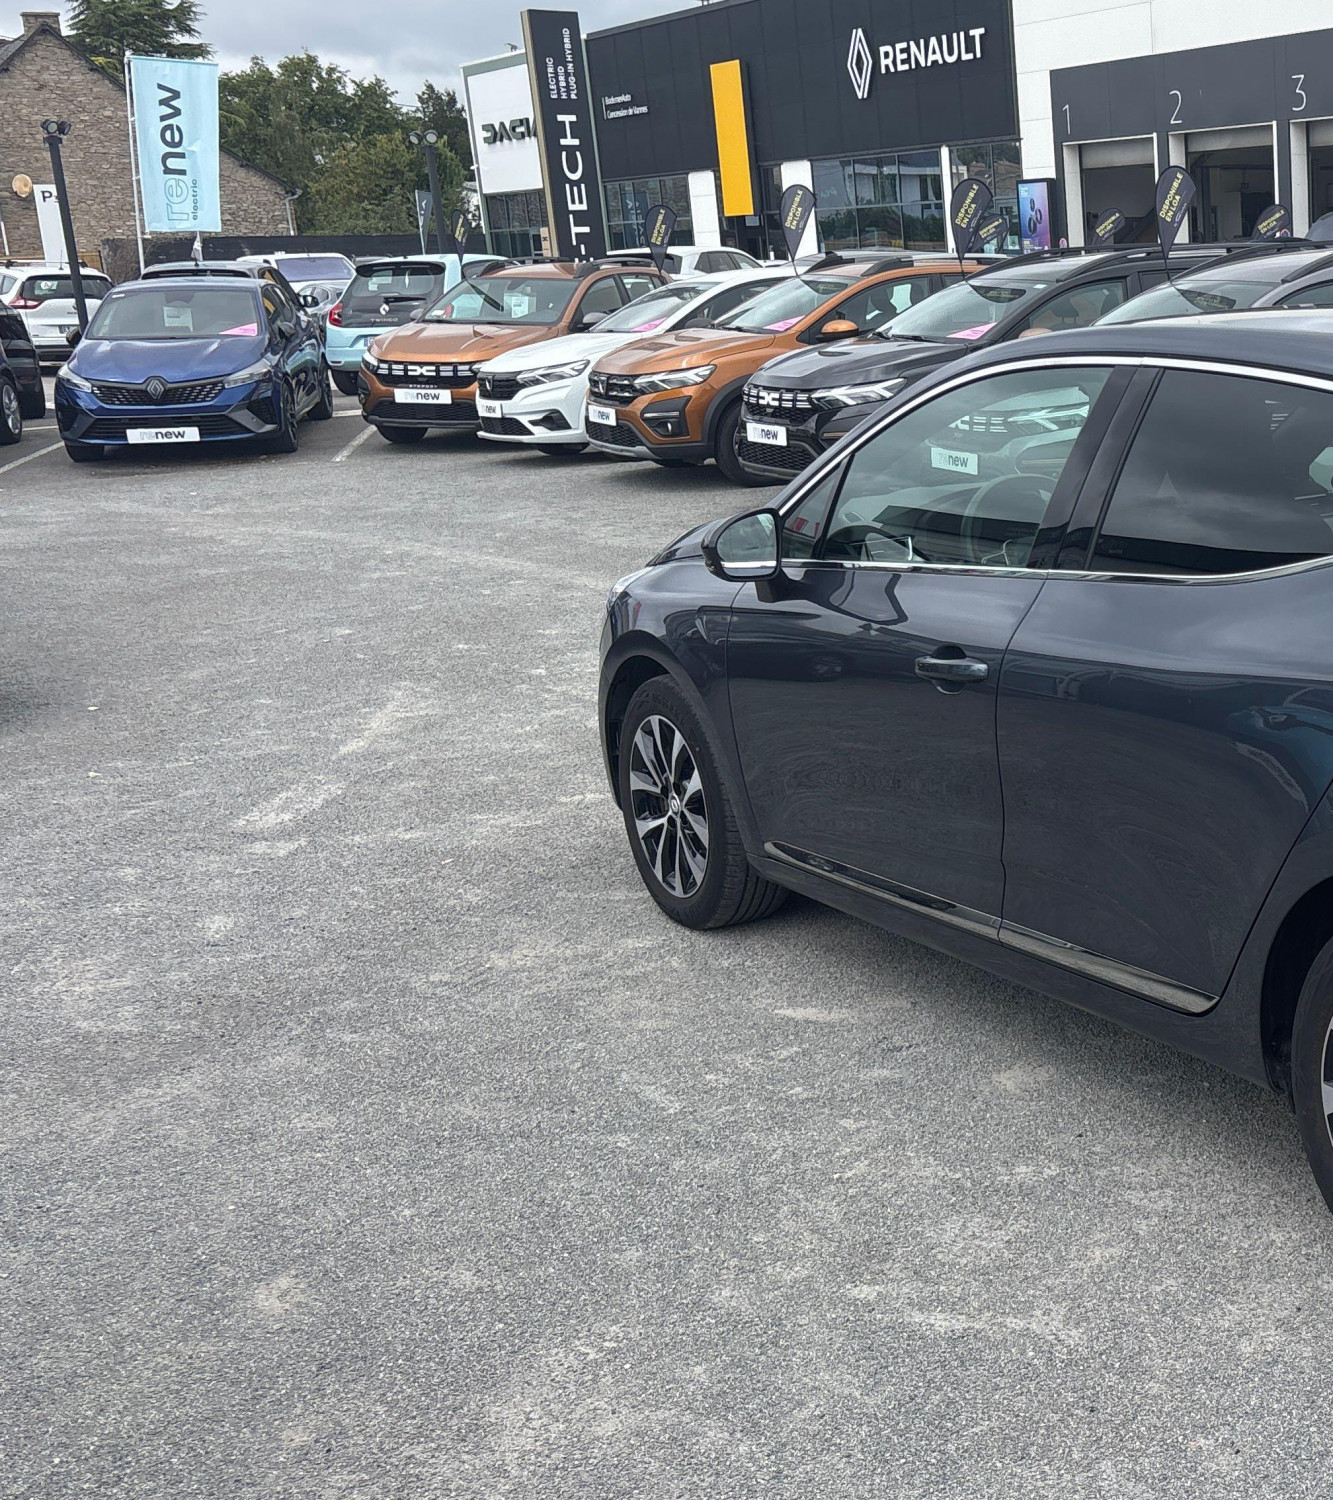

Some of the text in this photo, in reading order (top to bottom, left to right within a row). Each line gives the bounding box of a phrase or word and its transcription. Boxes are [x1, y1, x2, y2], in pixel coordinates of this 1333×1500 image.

[562, 27, 578, 100] PLUG-IN HYBRID
[878, 27, 986, 75] RENAULT
[545, 56, 558, 99] ELECTRIC
[557, 65, 568, 100] HYBRID
[1291, 74, 1307, 112] 3
[1062, 104, 1071, 136] 1
[1168, 90, 1183, 125] 2
[156, 82, 190, 221] renew
[556, 113, 595, 264] -TECH
[955, 183, 980, 225] DISPONIBLE
[1159, 171, 1184, 218] DISPONIBLE
[784, 189, 803, 228] DISPONIBLE
[790, 220, 798, 230] EN
[794, 207, 803, 221] LOA
[960, 216, 970, 228] EN
[965, 203, 977, 219] LOA
[1165, 210, 1174, 222] EN
[1170, 195, 1181, 211] LOA
[139, 429, 186, 440] renew
